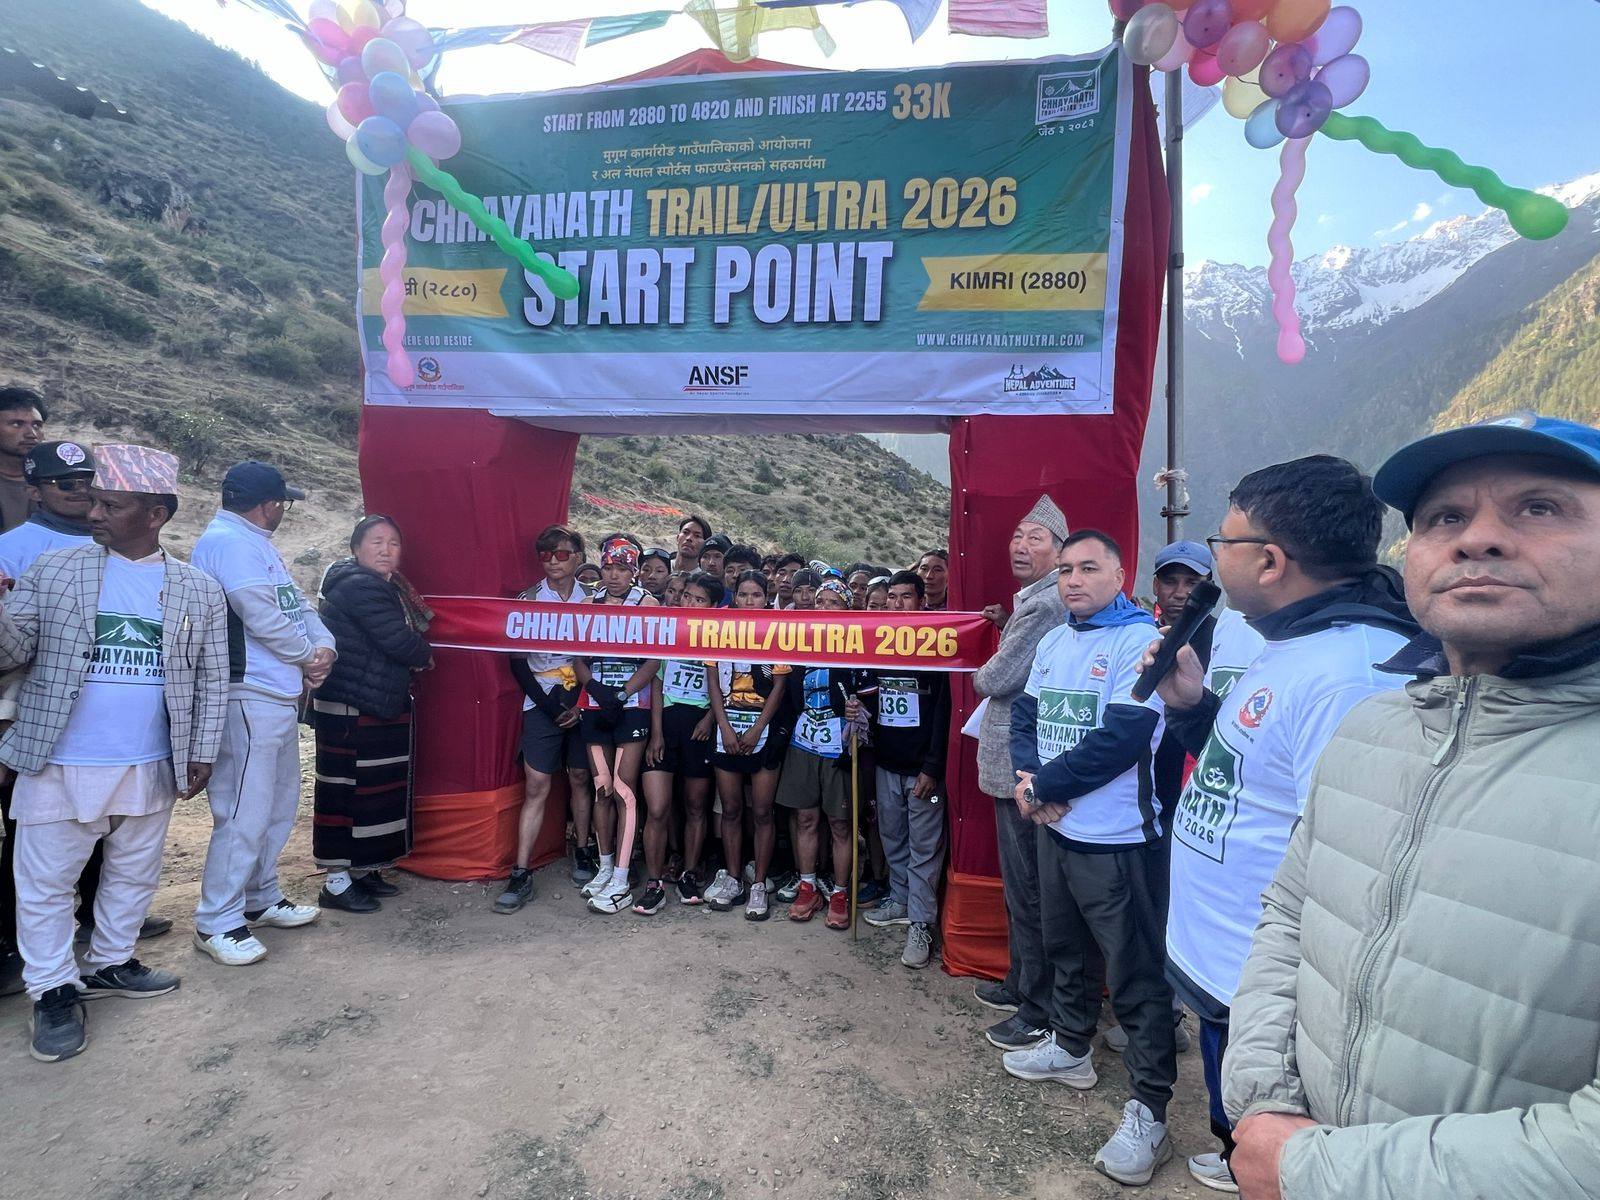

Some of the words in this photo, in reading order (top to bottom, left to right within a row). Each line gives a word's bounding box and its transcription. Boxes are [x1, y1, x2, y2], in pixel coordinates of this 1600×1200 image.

[543, 113, 583, 133] START
[587, 109, 625, 130] FROM
[629, 105, 666, 126] 2880
[671, 103, 687, 123] TO
[691, 99, 730, 121] 4820
[734, 98, 764, 118] AND
[768, 94, 816, 116] FINISH
[820, 93, 840, 113] AT
[844, 90, 887, 112] 2255
[892, 82, 951, 120] 33K
[1041, 91, 1094, 109] CHHAYANATH
[758, 135, 813, 152] आयोजना
[591, 170, 599, 181] र
[601, 167, 622, 180] अल
[624, 164, 654, 179] नेपाल
[769, 154, 827, 173] सहकार्यमा
[646, 179, 888, 237] TRAIL/ULTRA
[902, 176, 1018, 230] 2026
[422, 280, 477, 302] (२८८०)
[523, 247, 695, 326] START
[714, 241, 894, 325] POINT
[950, 271, 1014, 290] KIMRI
[1020, 270, 1088, 295] (2880)
[424, 335, 440, 346] GOD
[916, 333, 1085, 347] WWW.CHHAYANATHULTRA.COM
[688, 365, 749, 386] ANSF
[1005, 378, 1028, 391] NEPAL
[1029, 378, 1075, 390] ADVENTURE
[505, 611, 677, 646] CHHAYANATH
[687, 619, 865, 655] TRAIL/ULTRA
[874, 625, 959, 657] 2026
[672, 671, 704, 689] 175
[880, 696, 908, 715] 136
[801, 724, 832, 743] 173
[1184, 818, 1215, 844] 2026
